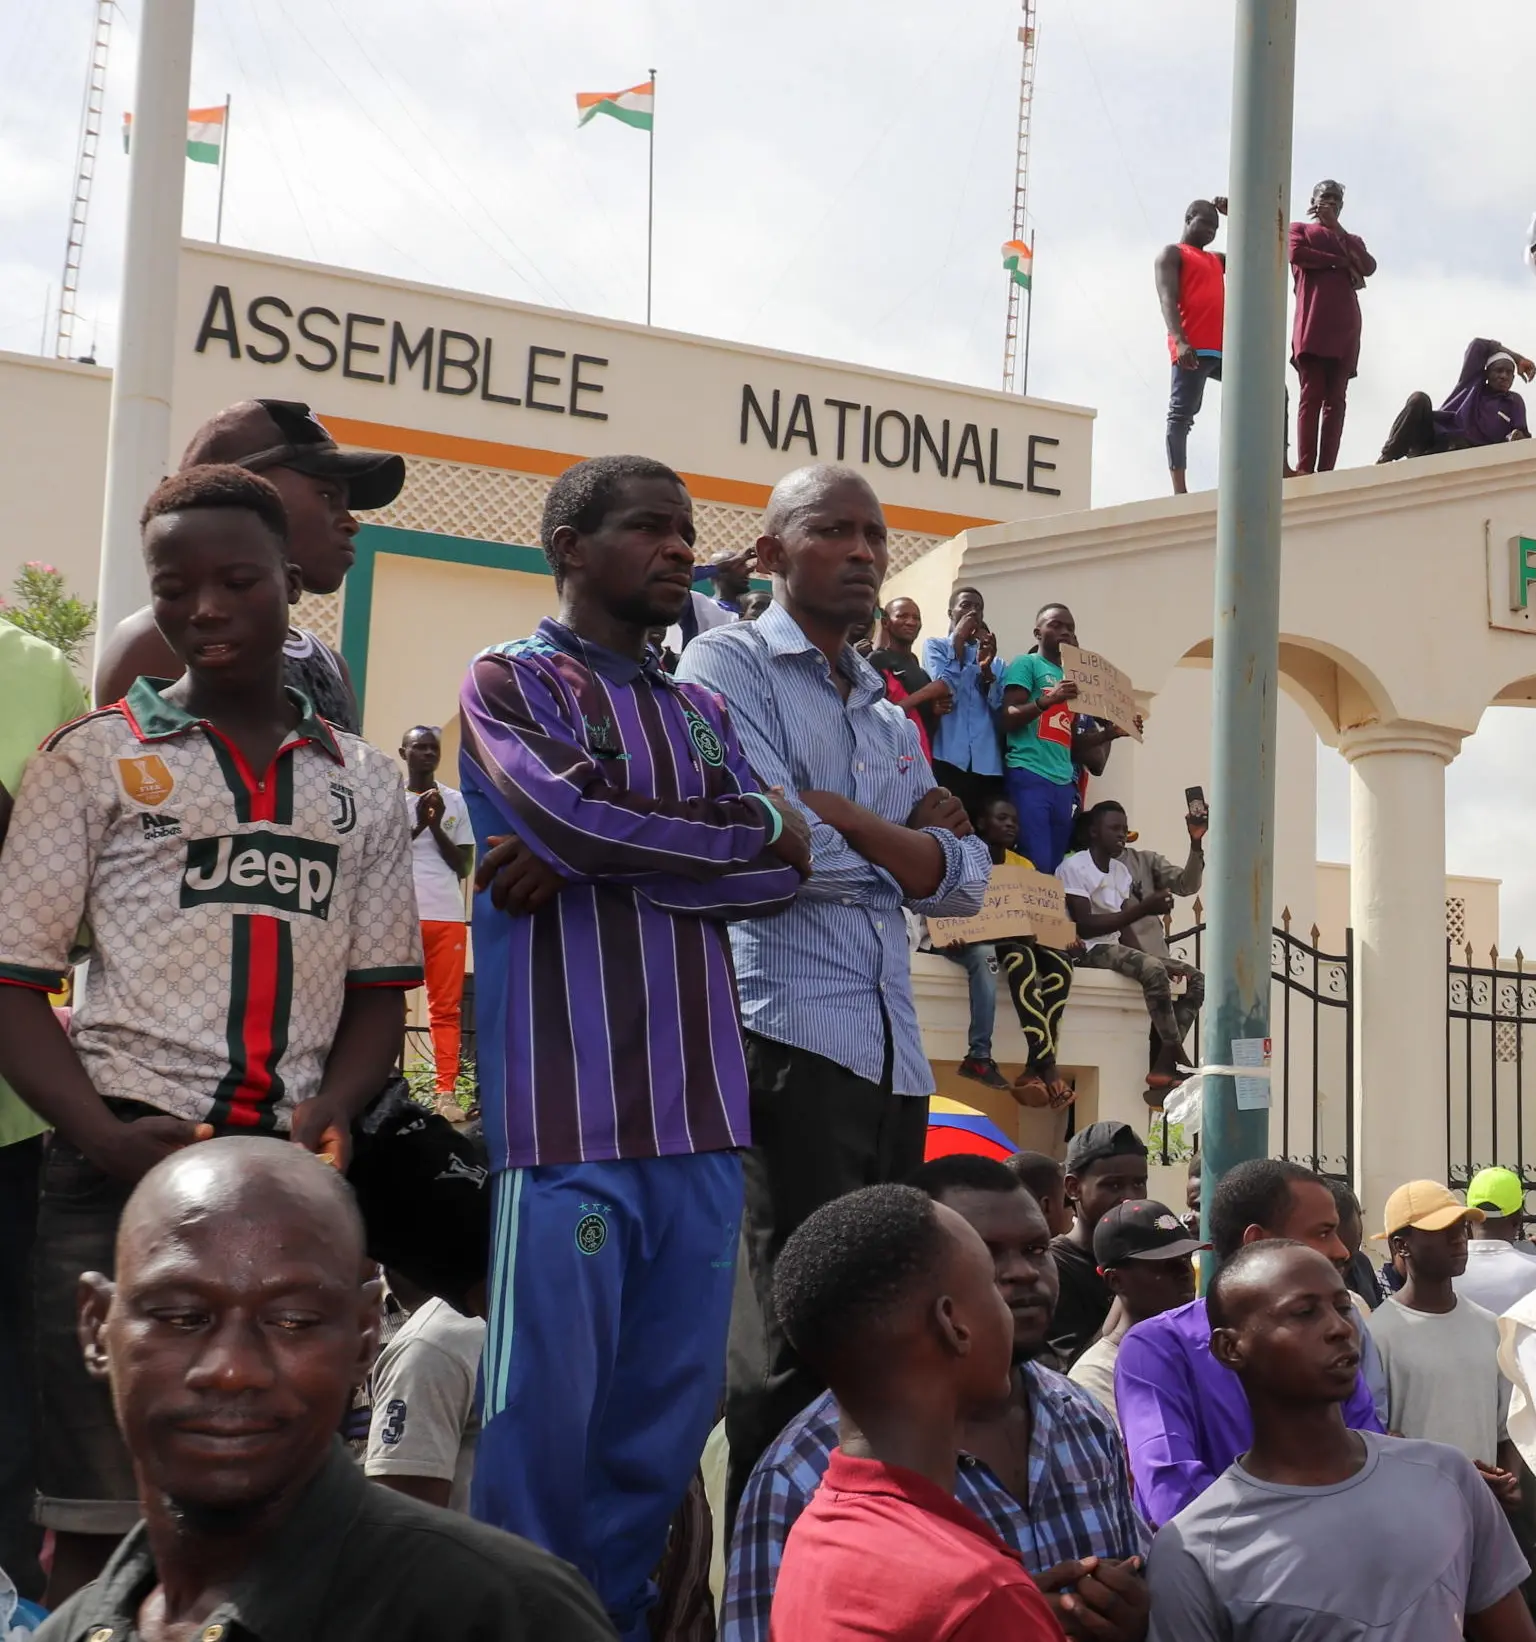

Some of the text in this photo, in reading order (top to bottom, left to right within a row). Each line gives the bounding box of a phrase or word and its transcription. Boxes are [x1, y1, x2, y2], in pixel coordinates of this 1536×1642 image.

[195, 286, 1061, 496] ASSEMBLEE NATIONALE
[1070, 669, 1100, 687] TOUS
[185, 837, 333, 911] Jeep
[382, 1400, 406, 1444] 3
